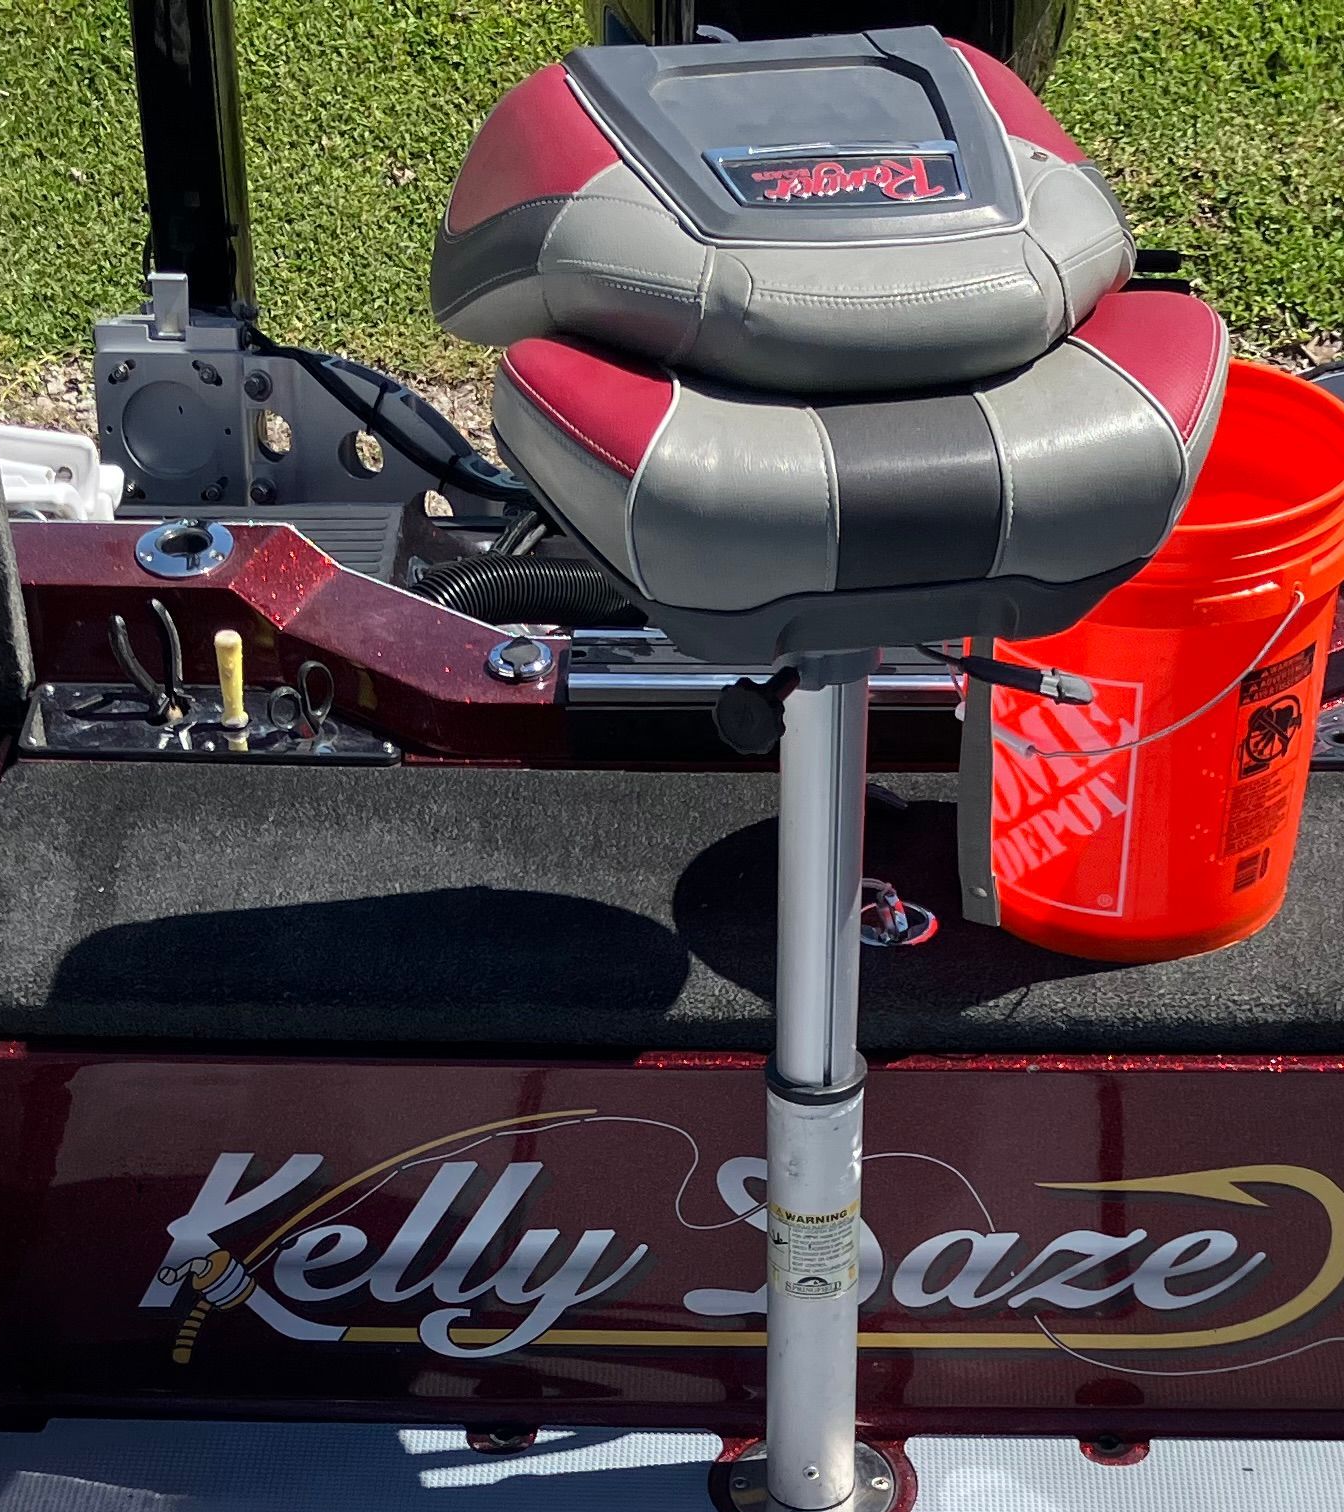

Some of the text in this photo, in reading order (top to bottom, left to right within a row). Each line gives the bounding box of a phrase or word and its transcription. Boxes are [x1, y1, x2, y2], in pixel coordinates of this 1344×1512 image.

[764, 157, 944, 200] Ranger
[993, 771, 1127, 884] DEPOT
[138, 1152, 649, 1358] Kelly
[785, 1210, 848, 1224] WARNING
